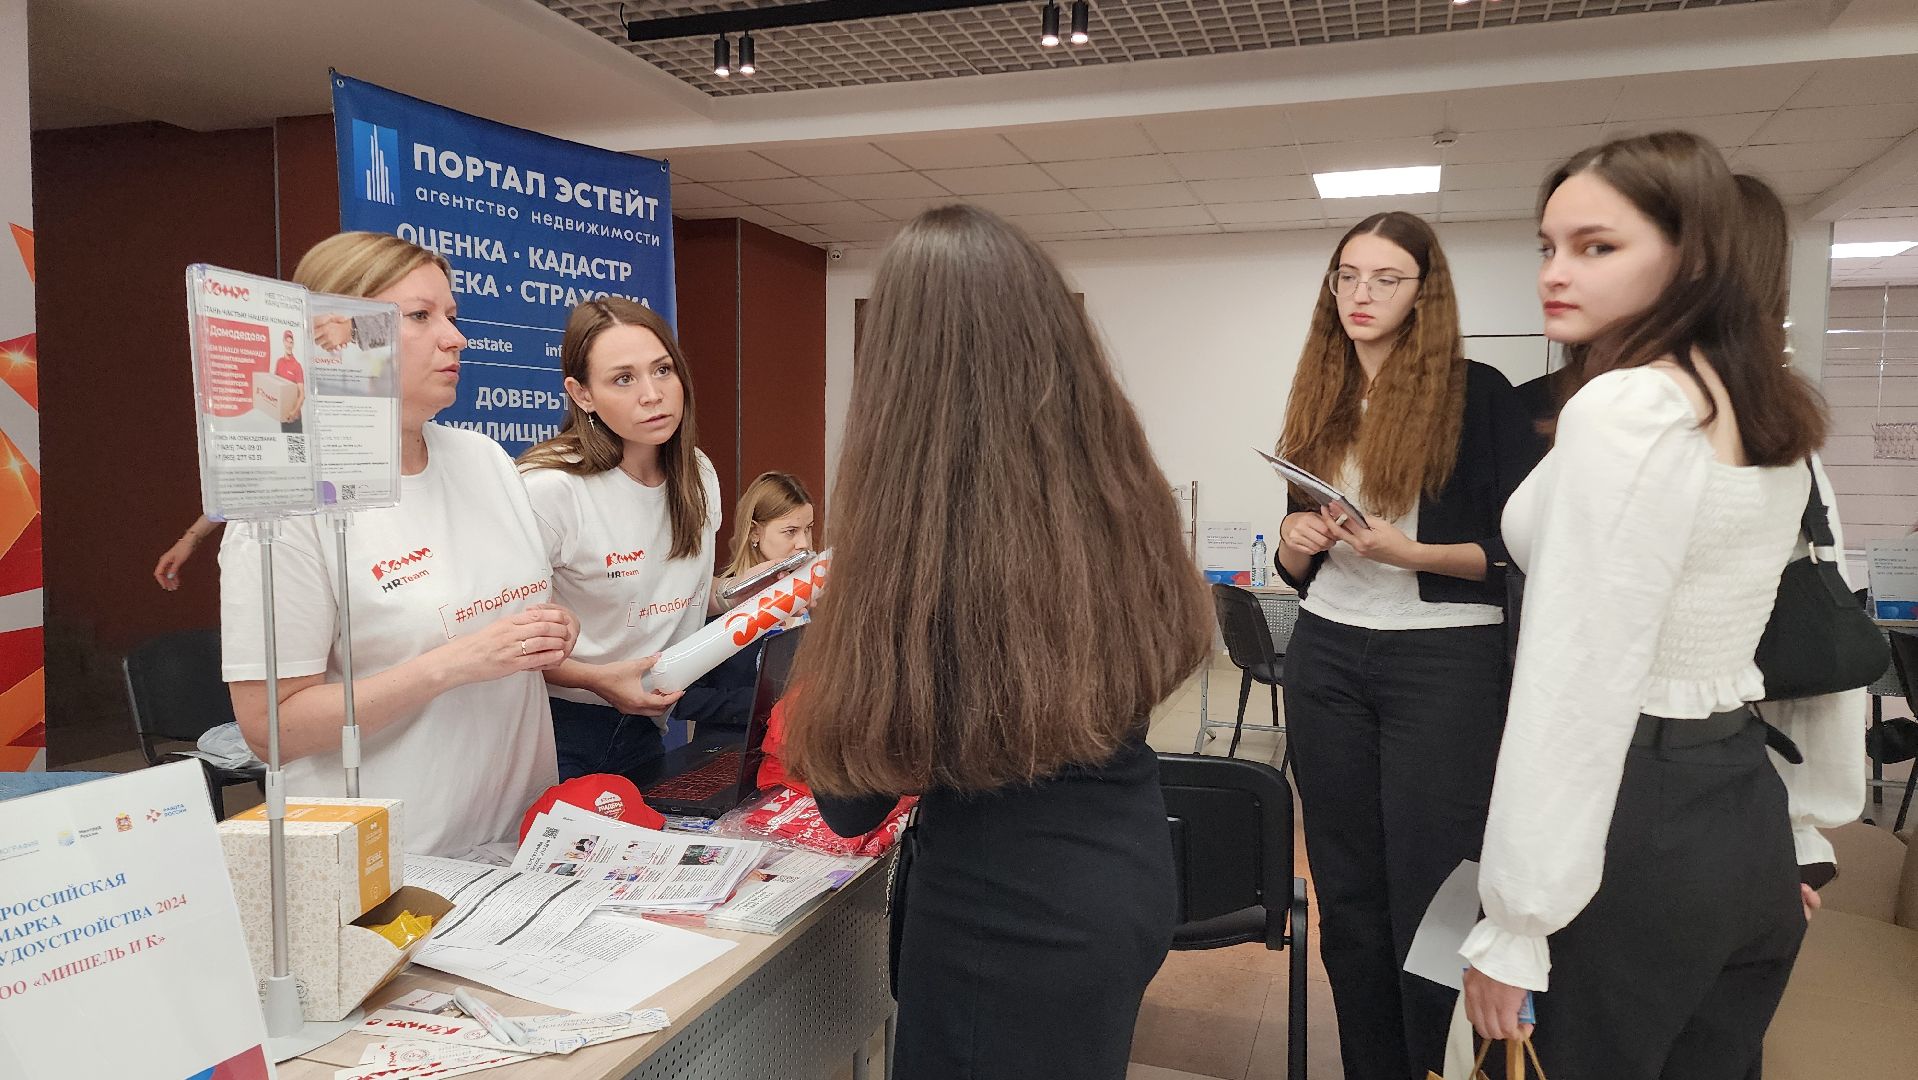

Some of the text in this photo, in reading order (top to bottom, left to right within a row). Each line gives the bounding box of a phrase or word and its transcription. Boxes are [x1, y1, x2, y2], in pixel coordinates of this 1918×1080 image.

[413, 143, 659, 222] ПОРТАЛ ЭСТЕЙТ
[415, 186, 660, 247] агентство недвижимости
[397, 222, 632, 282] ОЦЕНКА КАДАСТР
[450, 269, 499, 297] ЕКА
[545, 343, 562, 357] inf
[371, 547, 434, 582] Комус
[455, 579, 548, 624] #яПодбираю
[156, 893, 187, 914] 2024
[129, 939, 142, 955] И
[145, 933, 166, 949] К»
